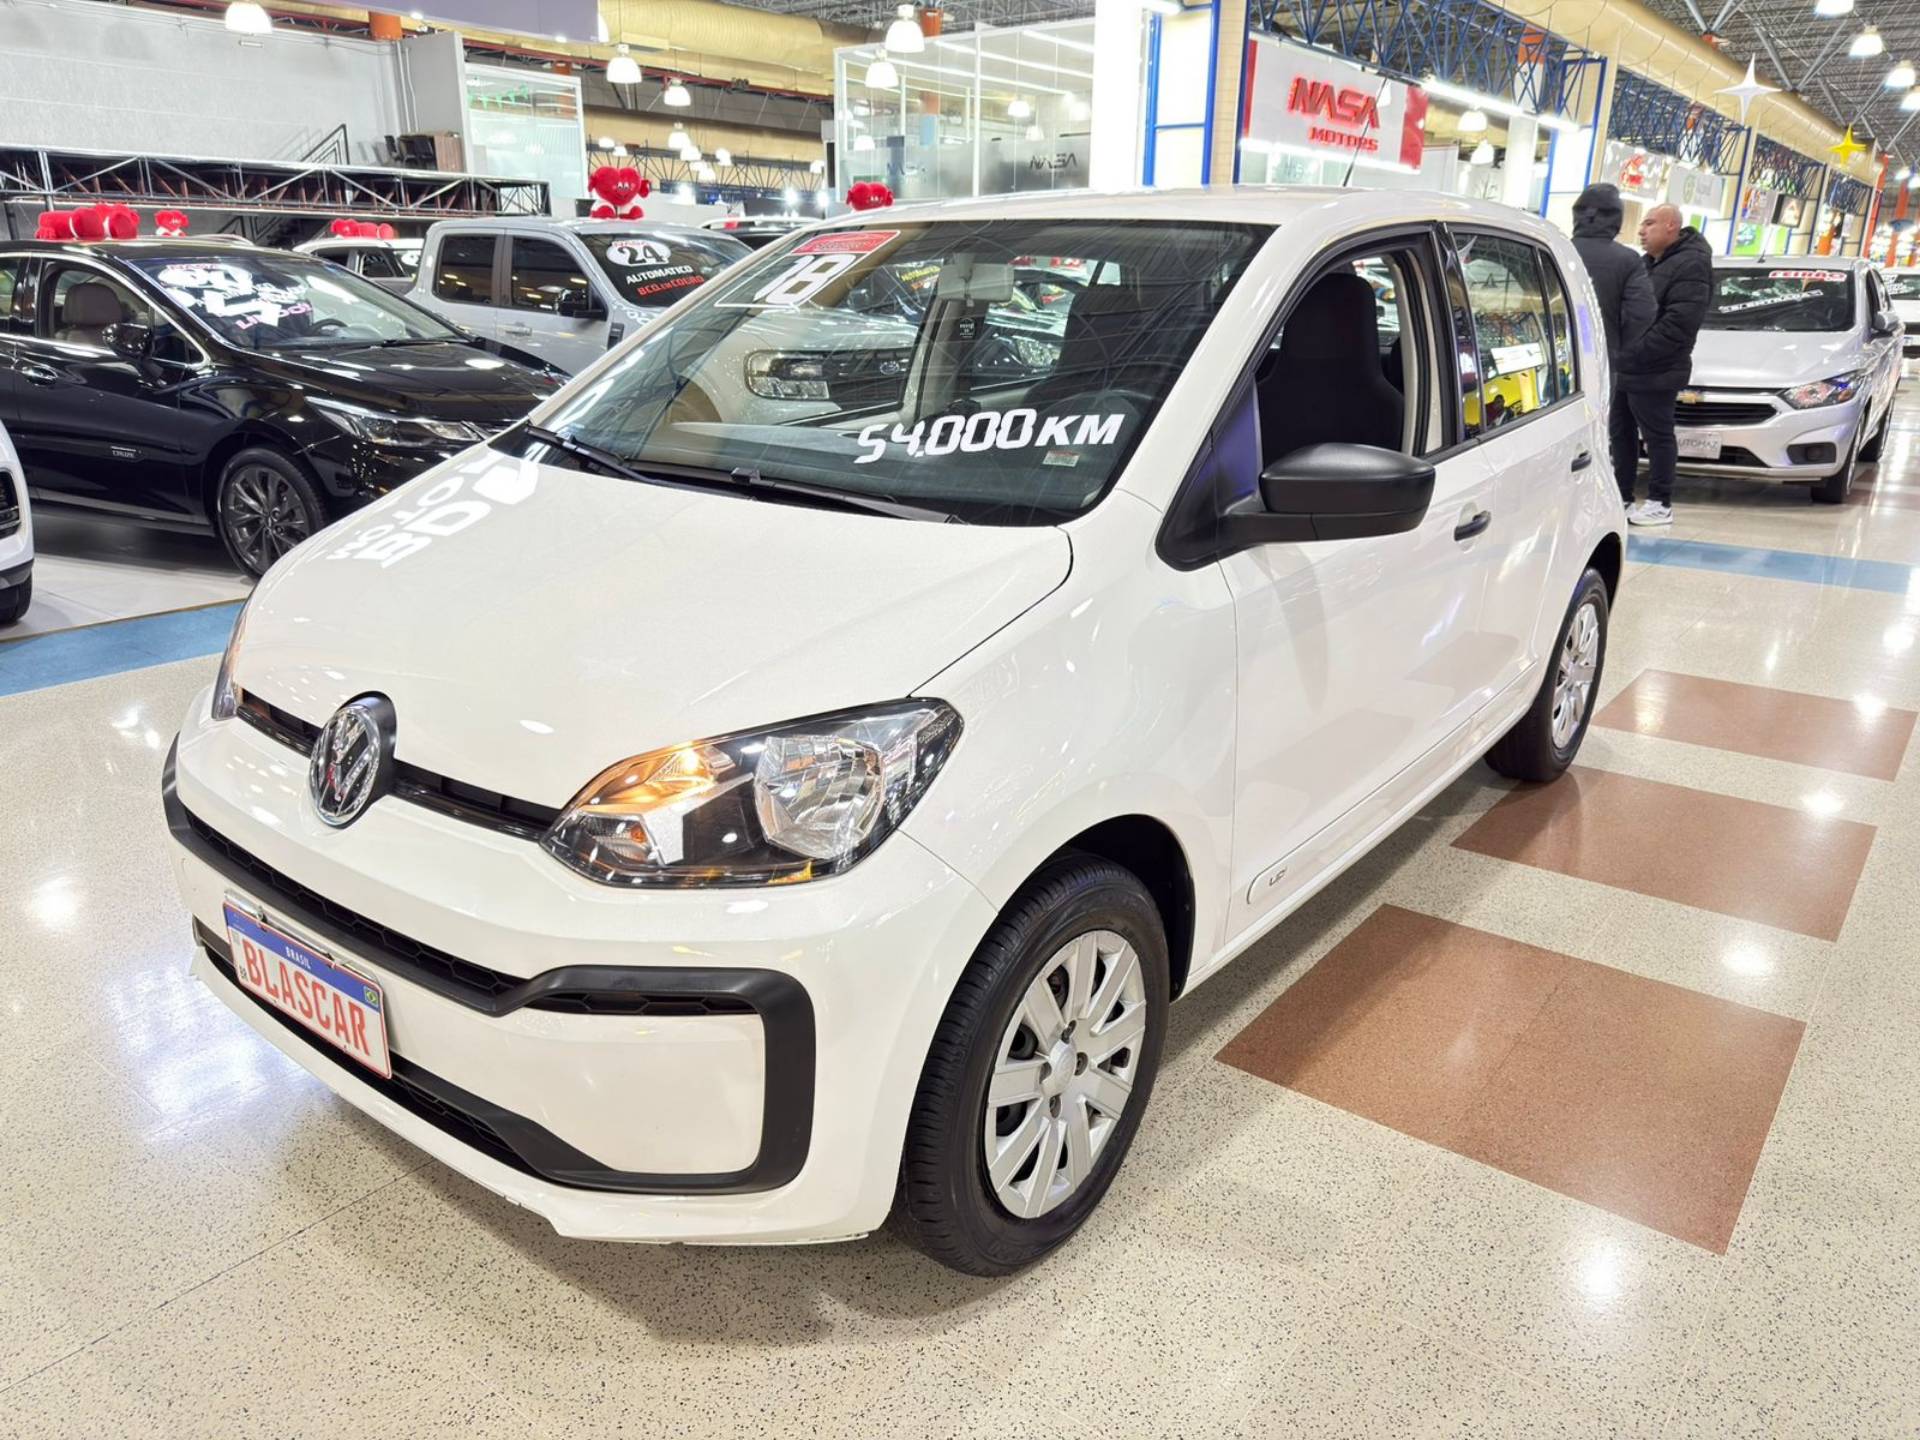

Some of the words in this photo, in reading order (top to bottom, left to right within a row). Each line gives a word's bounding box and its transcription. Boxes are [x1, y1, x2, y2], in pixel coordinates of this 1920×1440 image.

[1289, 77, 1381, 129] NASA
[1309, 127, 1379, 151] MOTORS
[617, 245, 666, 265] 24
[753, 254, 857, 304] 18
[1034, 413, 1126, 447] KM
[285, 945, 312, 971] BRASIL
[242, 938, 371, 1057] BLASCAR
